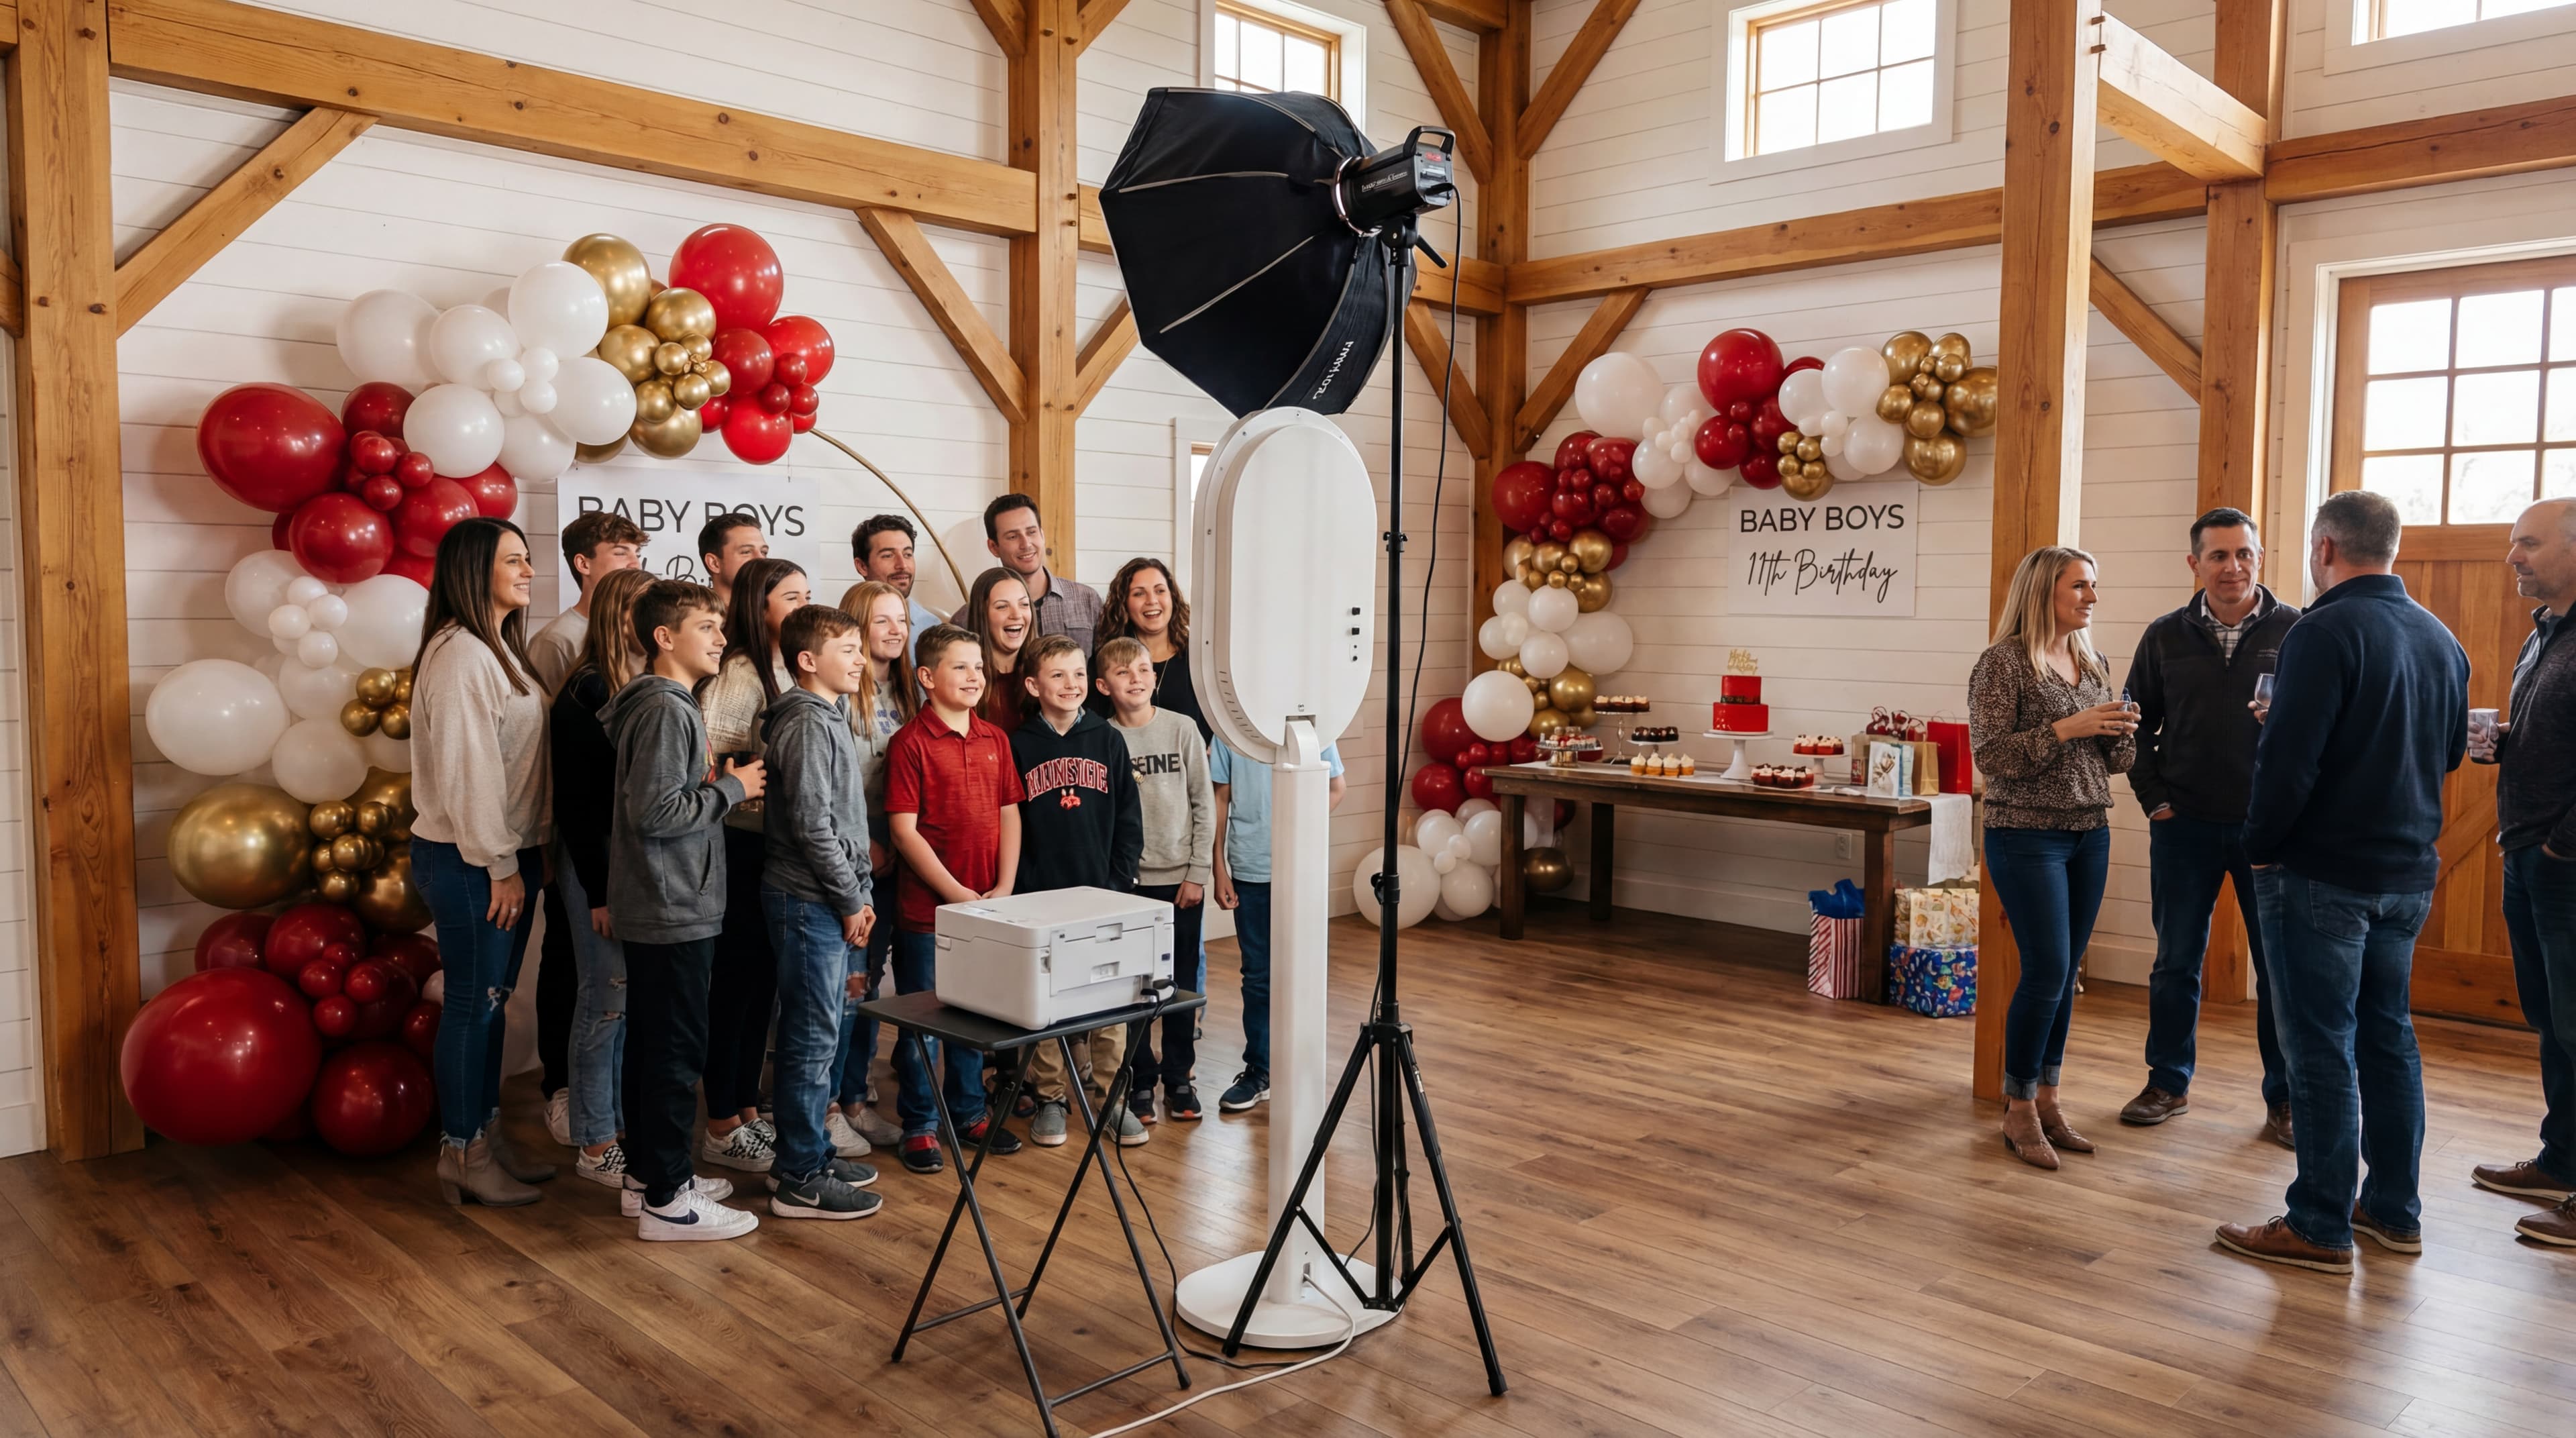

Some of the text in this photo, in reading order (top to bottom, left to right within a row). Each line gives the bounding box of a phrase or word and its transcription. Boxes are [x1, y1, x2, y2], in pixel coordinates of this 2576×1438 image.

[578, 496, 691, 533] BABY
[1740, 504, 1904, 533] BABY BOYS
[1748, 548, 1898, 603] 11th Birthday
